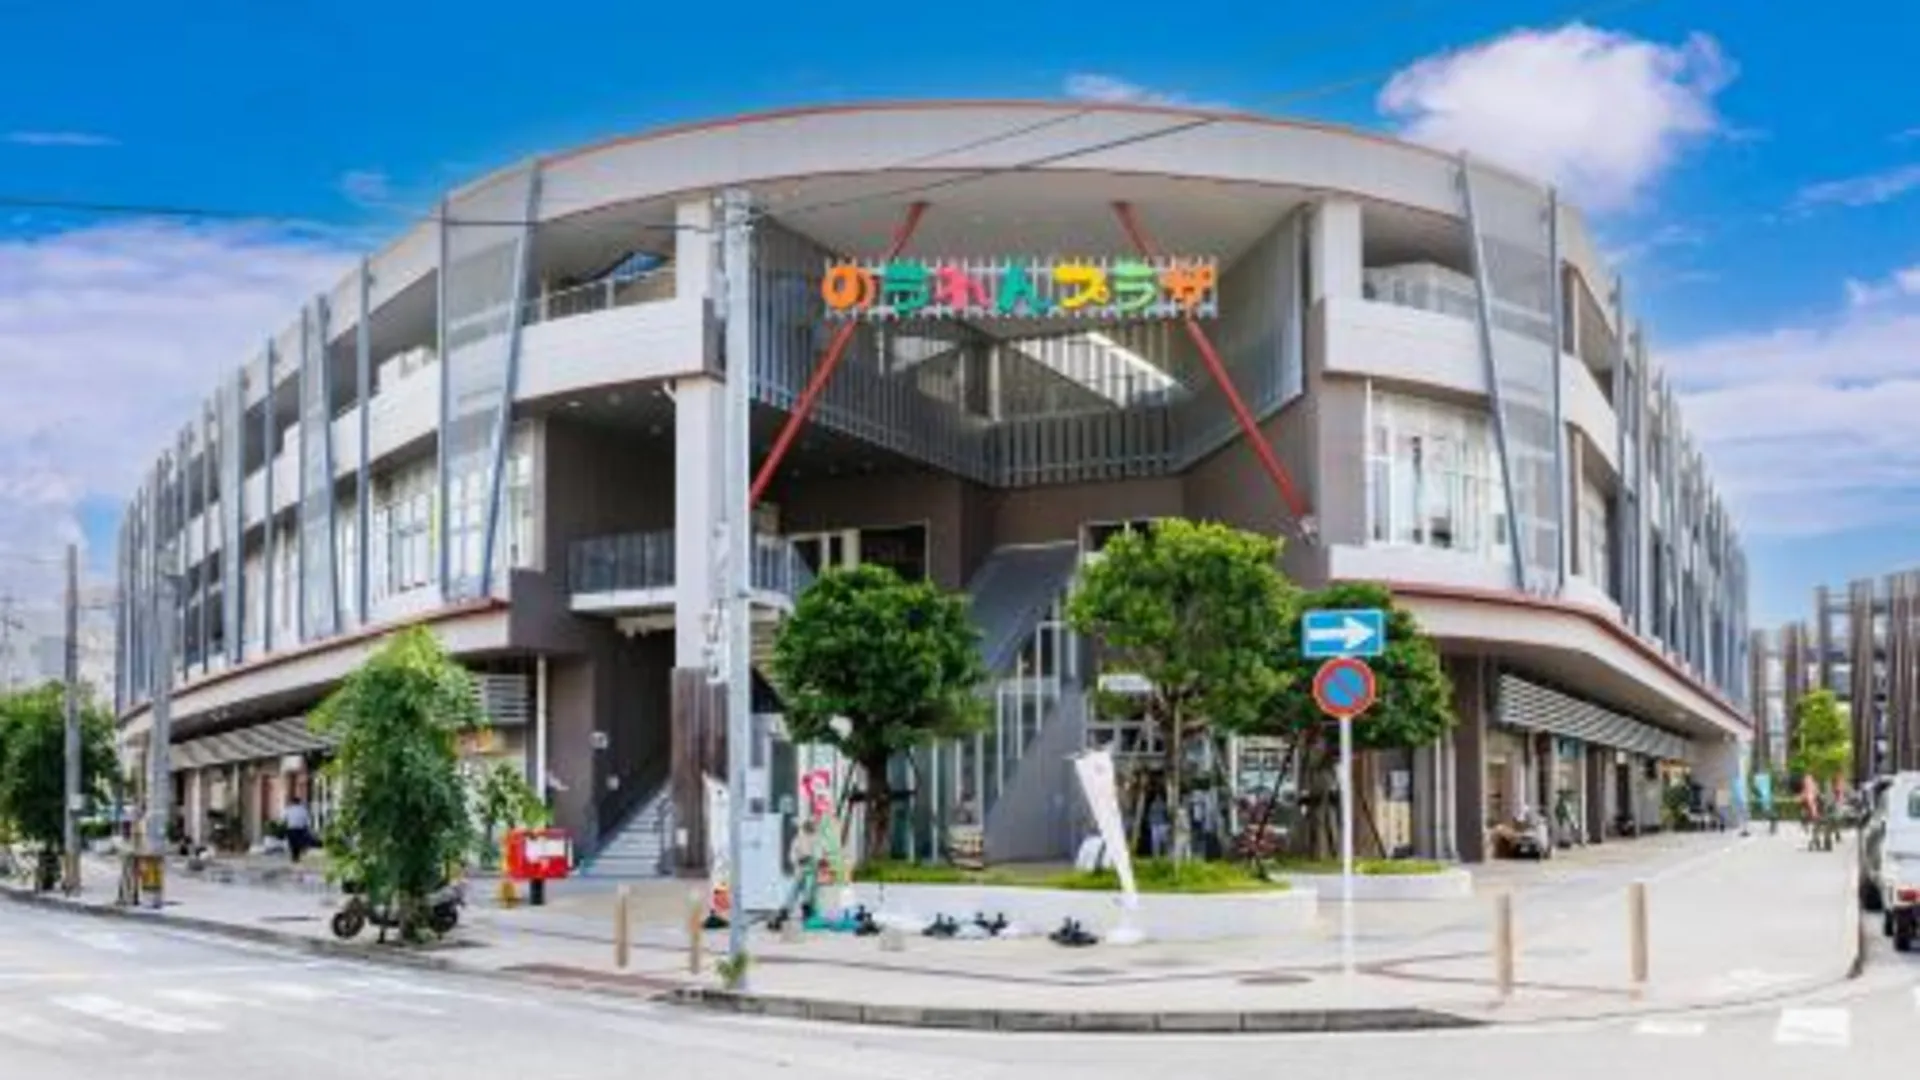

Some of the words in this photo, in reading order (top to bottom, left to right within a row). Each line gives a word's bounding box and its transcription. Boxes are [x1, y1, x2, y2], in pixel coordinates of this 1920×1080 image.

[821, 260, 1215, 314] のうれんプラザ
